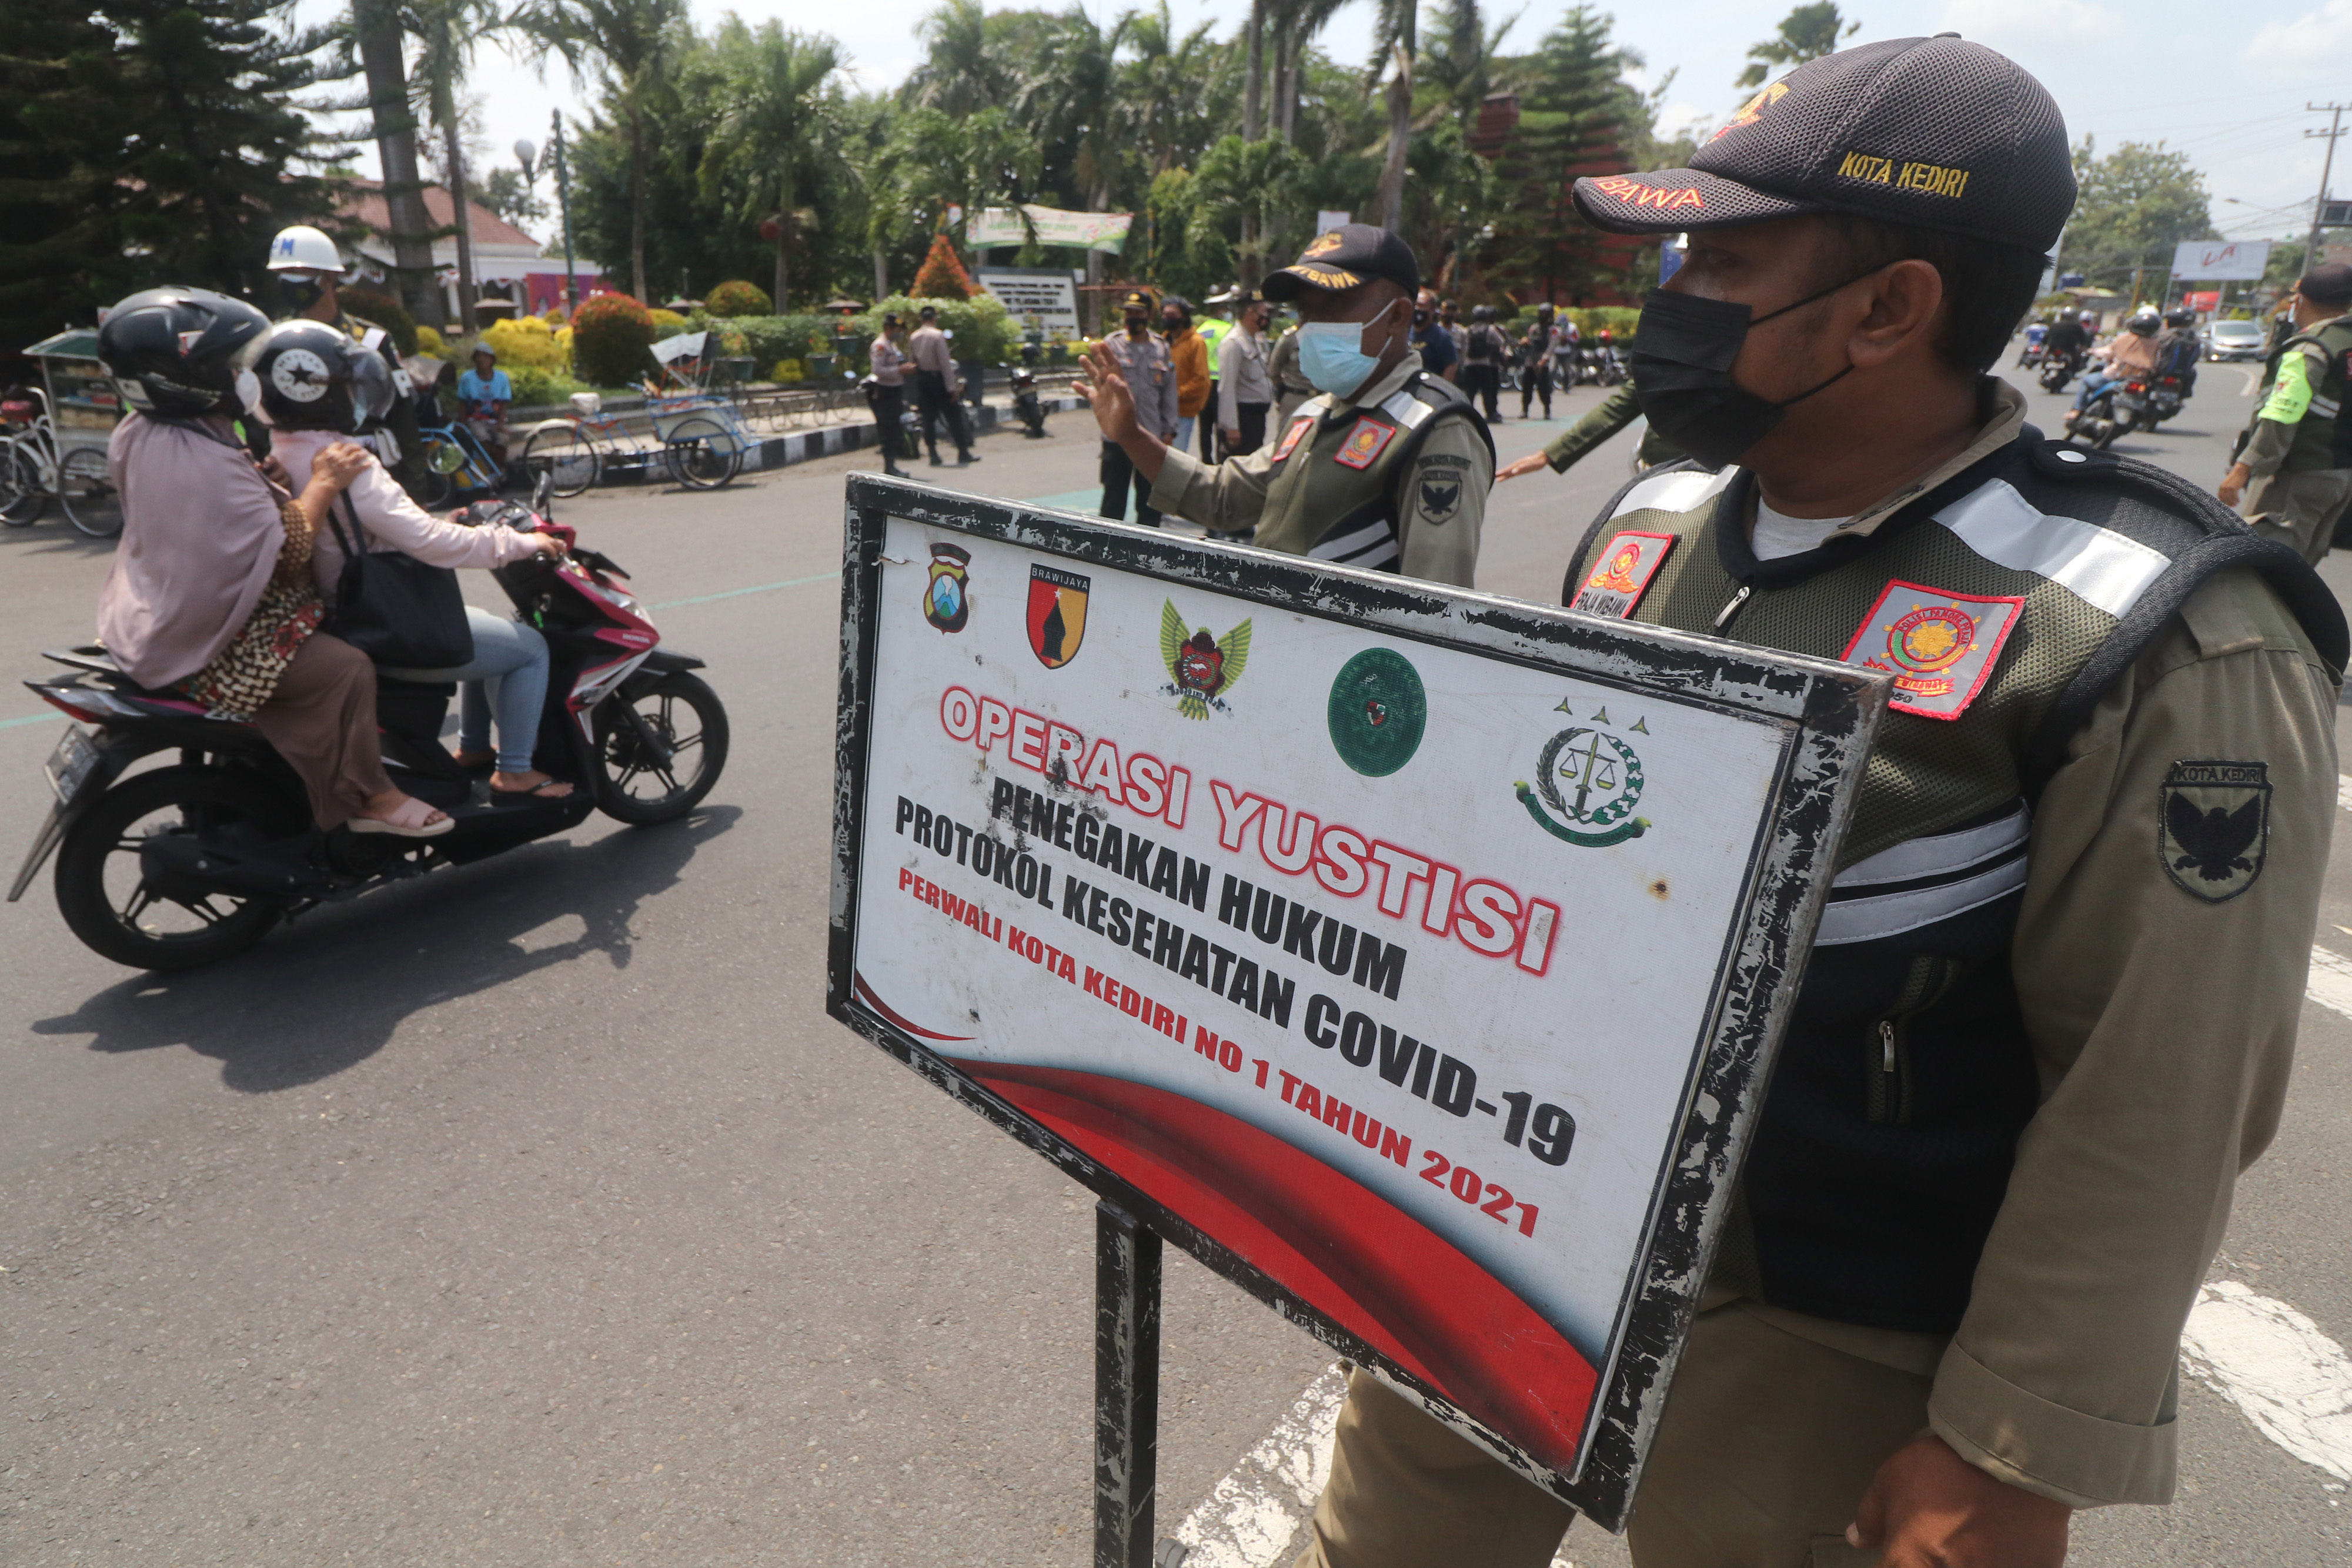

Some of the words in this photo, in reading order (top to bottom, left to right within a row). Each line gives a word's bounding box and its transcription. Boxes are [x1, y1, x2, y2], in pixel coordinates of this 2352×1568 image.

[1837, 151, 1893, 183] KOTA
[1896, 162, 1969, 198] KEDIRI
[1032, 567, 1088, 590] BRAWIJAYA
[941, 686, 1190, 828] OPERASI
[1210, 779, 1561, 977] YUSTISI
[2177, 767, 2218, 781] KOTA
[2221, 767, 2261, 782] KEDIRI
[896, 795, 1054, 910] PROTOKOL
[1062, 874, 1295, 1029] KESEHATAN
[1304, 994, 1576, 1166] COVID-19
[991, 777, 1211, 913] PENEGAKAN
[1218, 873, 1407, 1001] HUKUM
[898, 867, 1002, 943] PERWALI
[1007, 925, 1076, 985] KOTA
[1083, 966, 1188, 1044] KEDIRI
[1194, 1025, 1242, 1073] NO
[1252, 1059, 1269, 1089] 1
[1278, 1068, 1412, 1168] TAHUN
[1419, 1149, 1539, 1238] 2021
